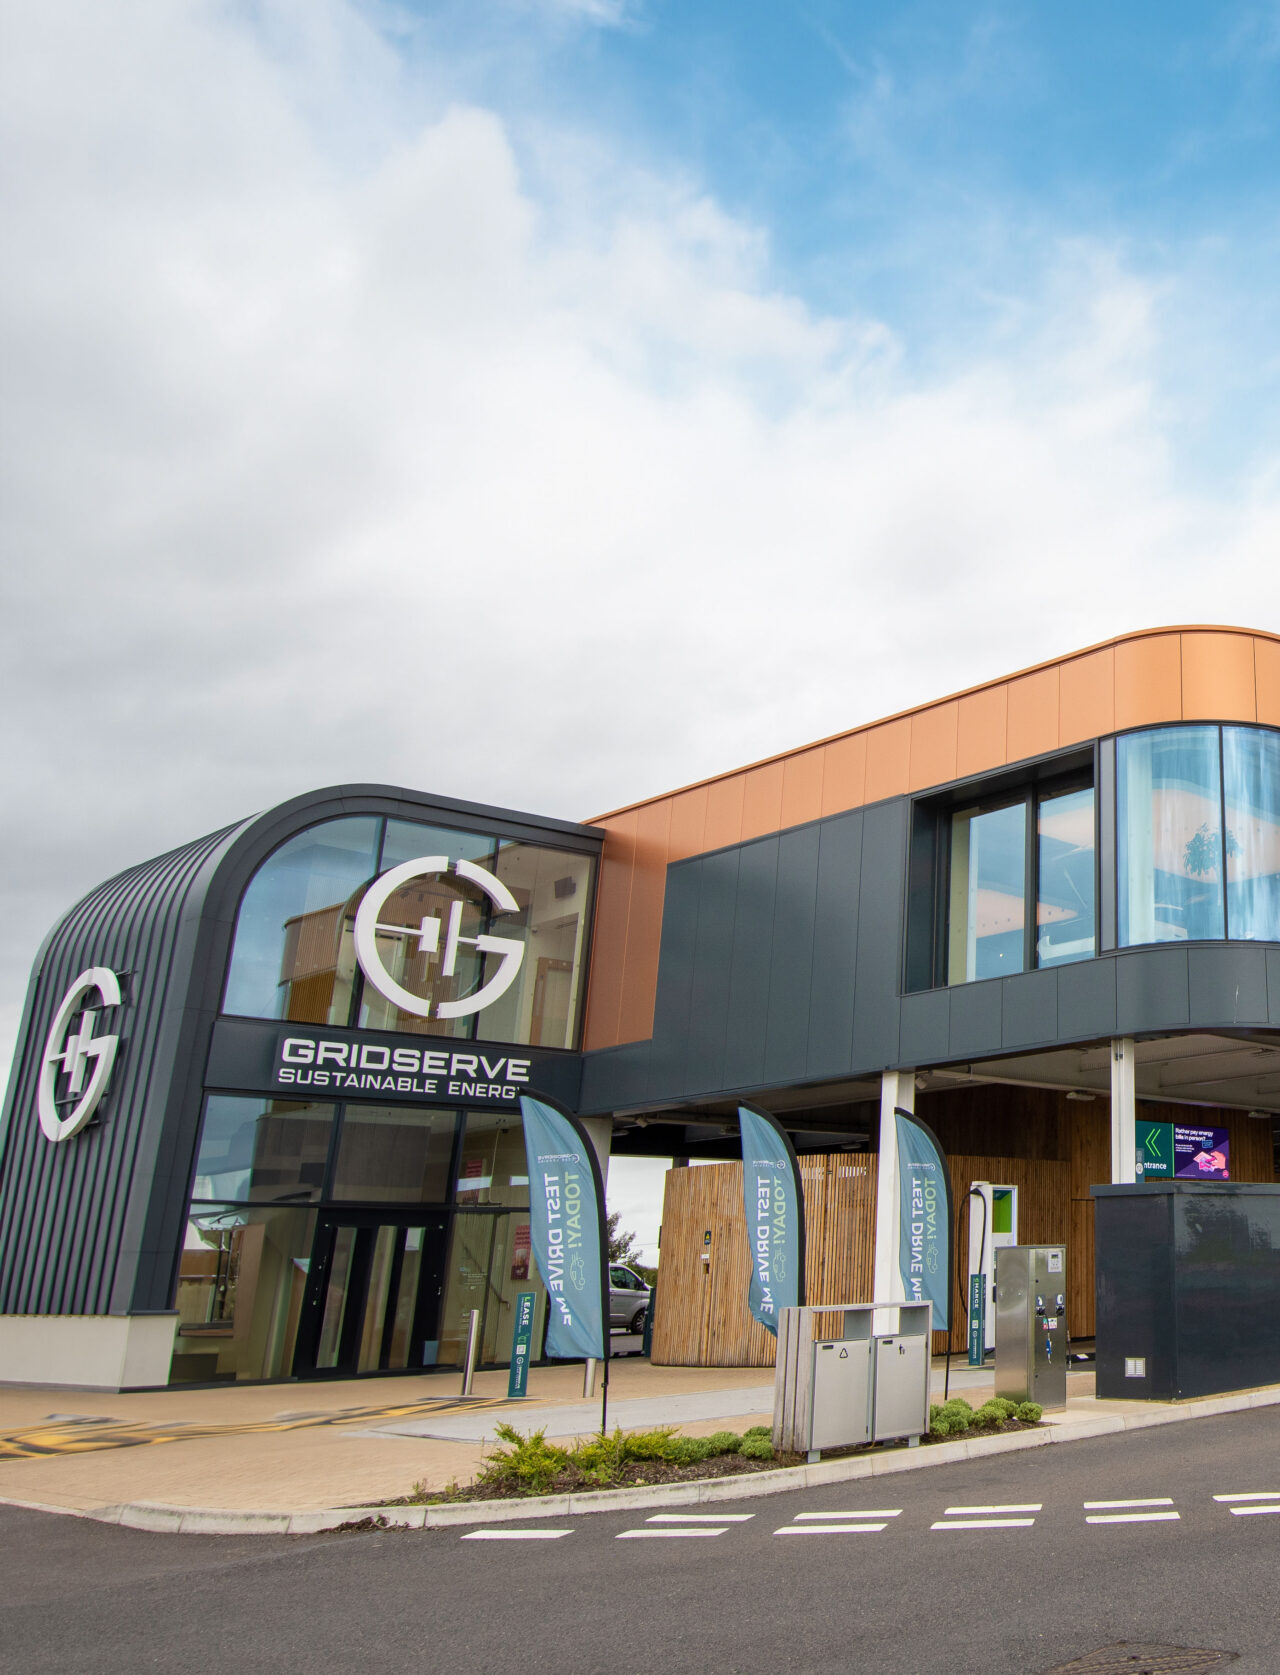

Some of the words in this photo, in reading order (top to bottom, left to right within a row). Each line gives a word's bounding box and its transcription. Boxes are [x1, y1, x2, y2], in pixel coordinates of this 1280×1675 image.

[281, 1037, 532, 1082] GRIDSERVE
[278, 1068, 438, 1094] SUSTAINABLE
[448, 1081, 520, 1100] ENERG
[1143, 1162, 1167, 1170] ntrance
[522, 1296, 532, 1326] LEASE
